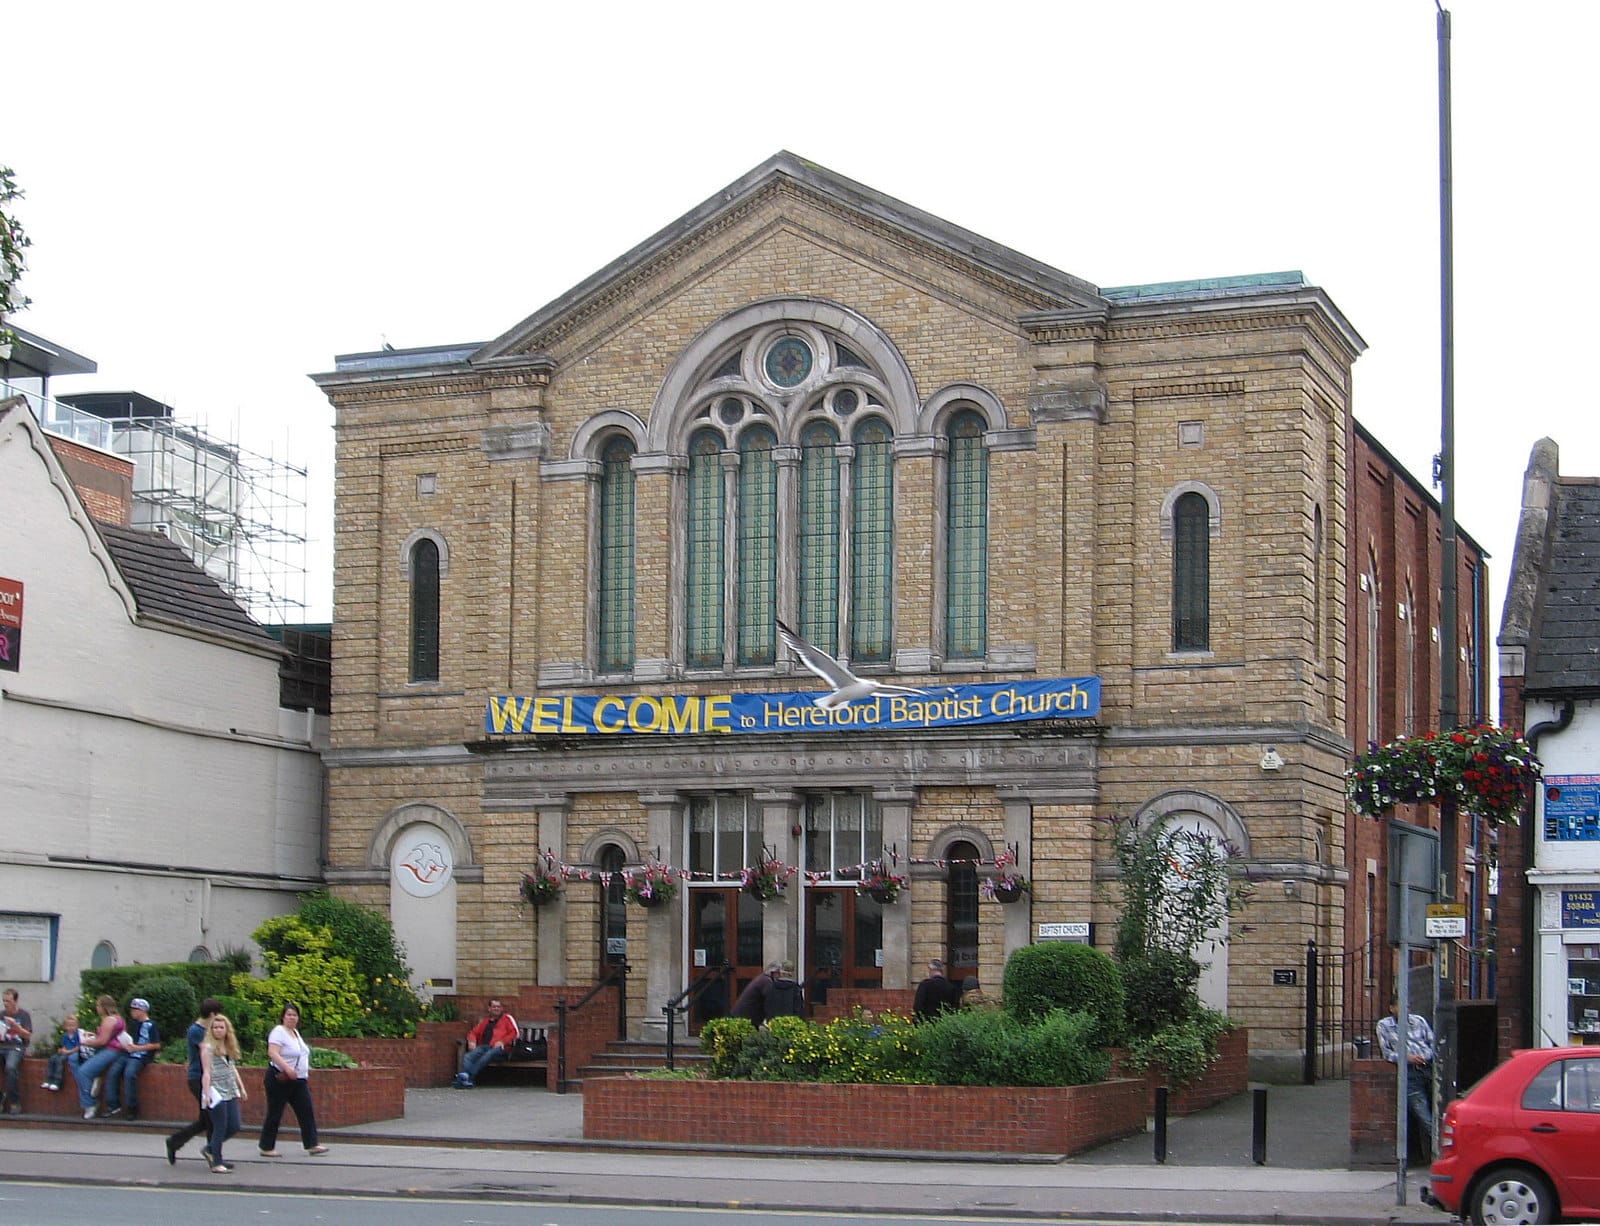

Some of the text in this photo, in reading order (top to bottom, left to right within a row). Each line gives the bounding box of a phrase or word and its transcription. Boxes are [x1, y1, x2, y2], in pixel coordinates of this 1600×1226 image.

[489, 695, 732, 733] WELCOME
[741, 714, 756, 728] to
[890, 694, 983, 726] Baptist
[990, 684, 1088, 715] Church
[1040, 924, 1087, 936] BAPTIST CHURCH
